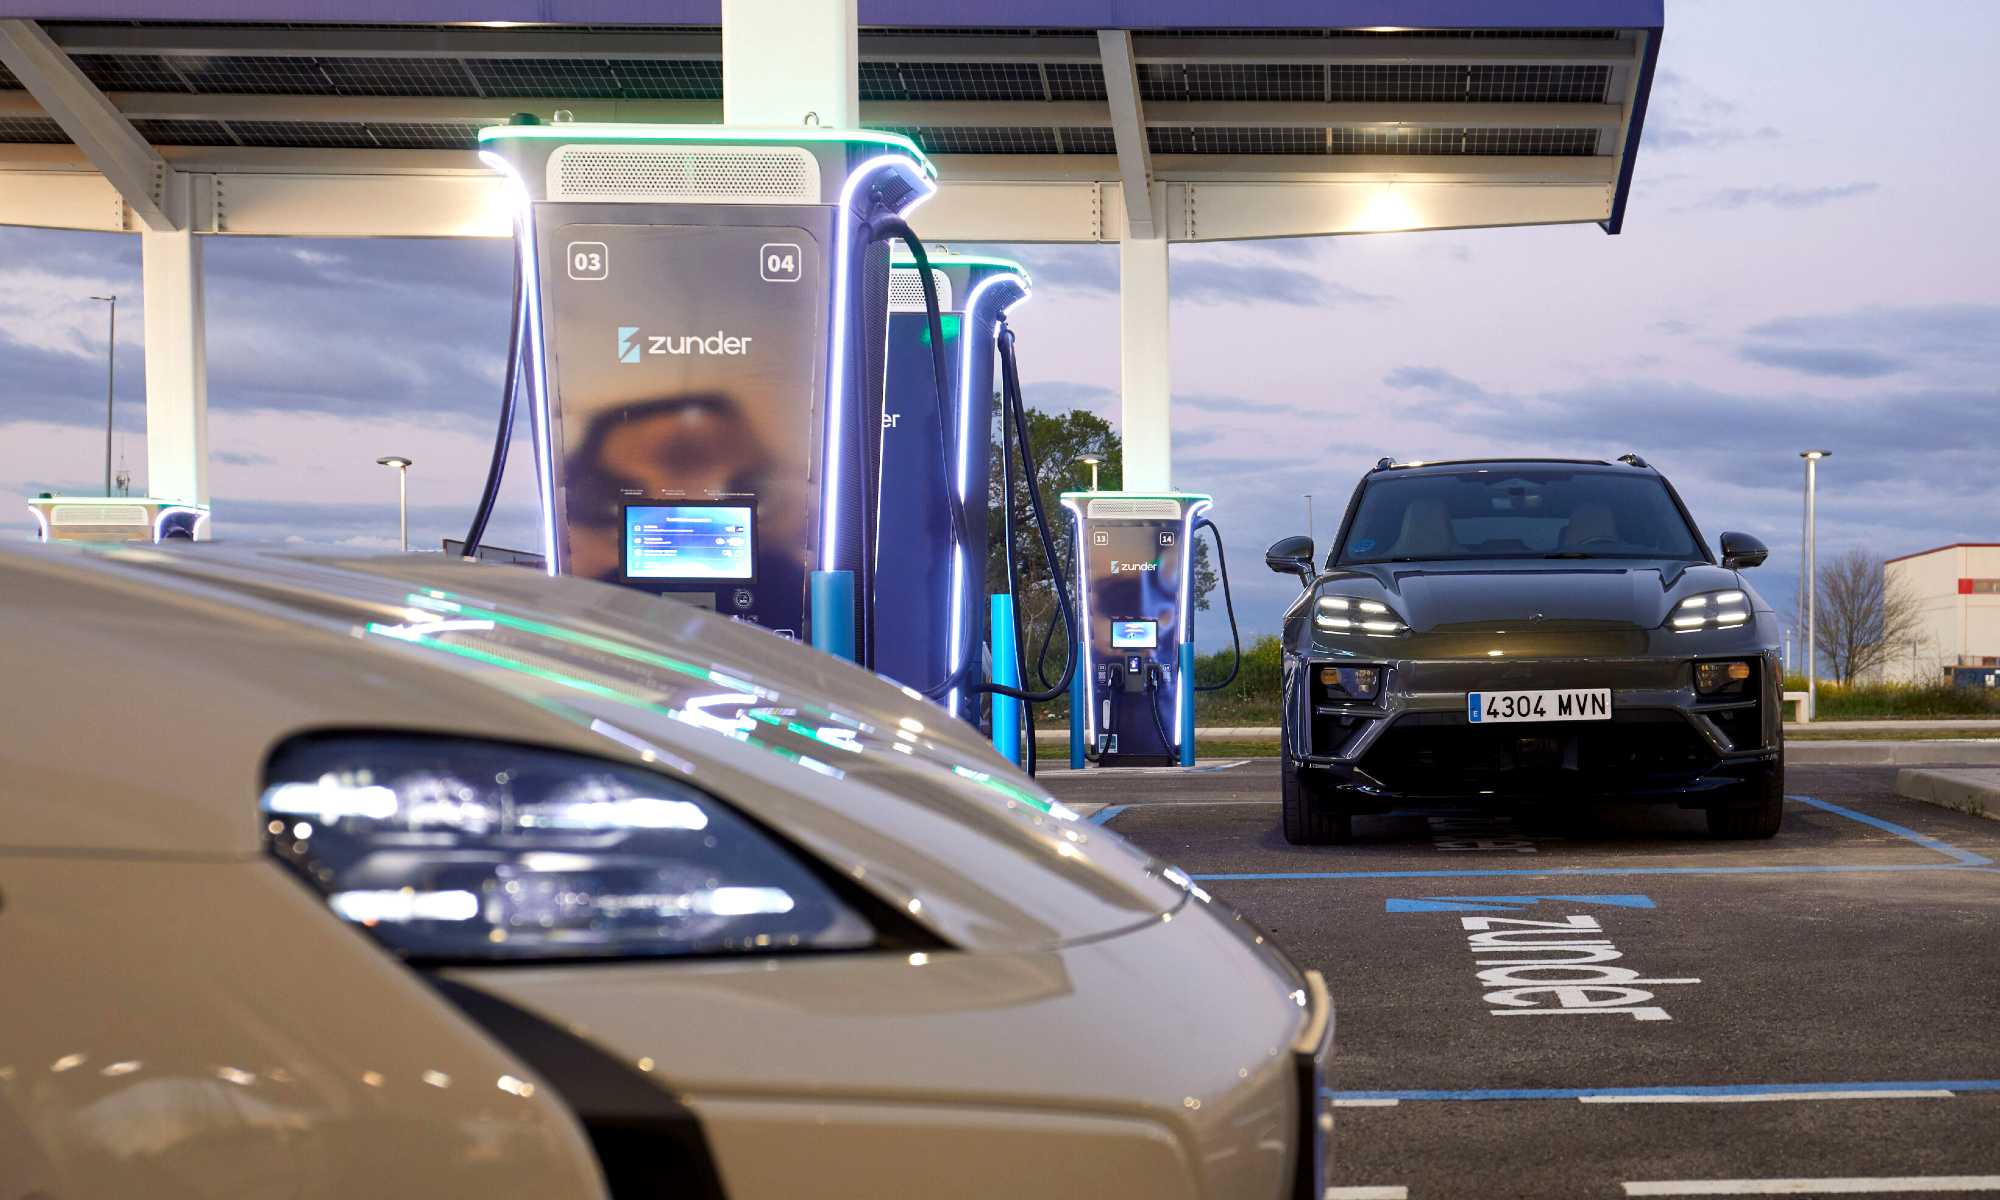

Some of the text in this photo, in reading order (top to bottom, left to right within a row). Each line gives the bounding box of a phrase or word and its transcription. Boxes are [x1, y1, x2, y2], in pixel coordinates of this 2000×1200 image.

[574, 252, 601, 271] 03
[767, 254, 795, 273] 04
[648, 330, 752, 355] zunder
[1096, 535, 1106, 543] 13
[1162, 535, 1172, 543] 14
[1121, 561, 1157, 571] zunder
[1486, 695, 1546, 718] 4304
[1557, 693, 1606, 716] MVN
[1461, 915, 1701, 1021] zunder
